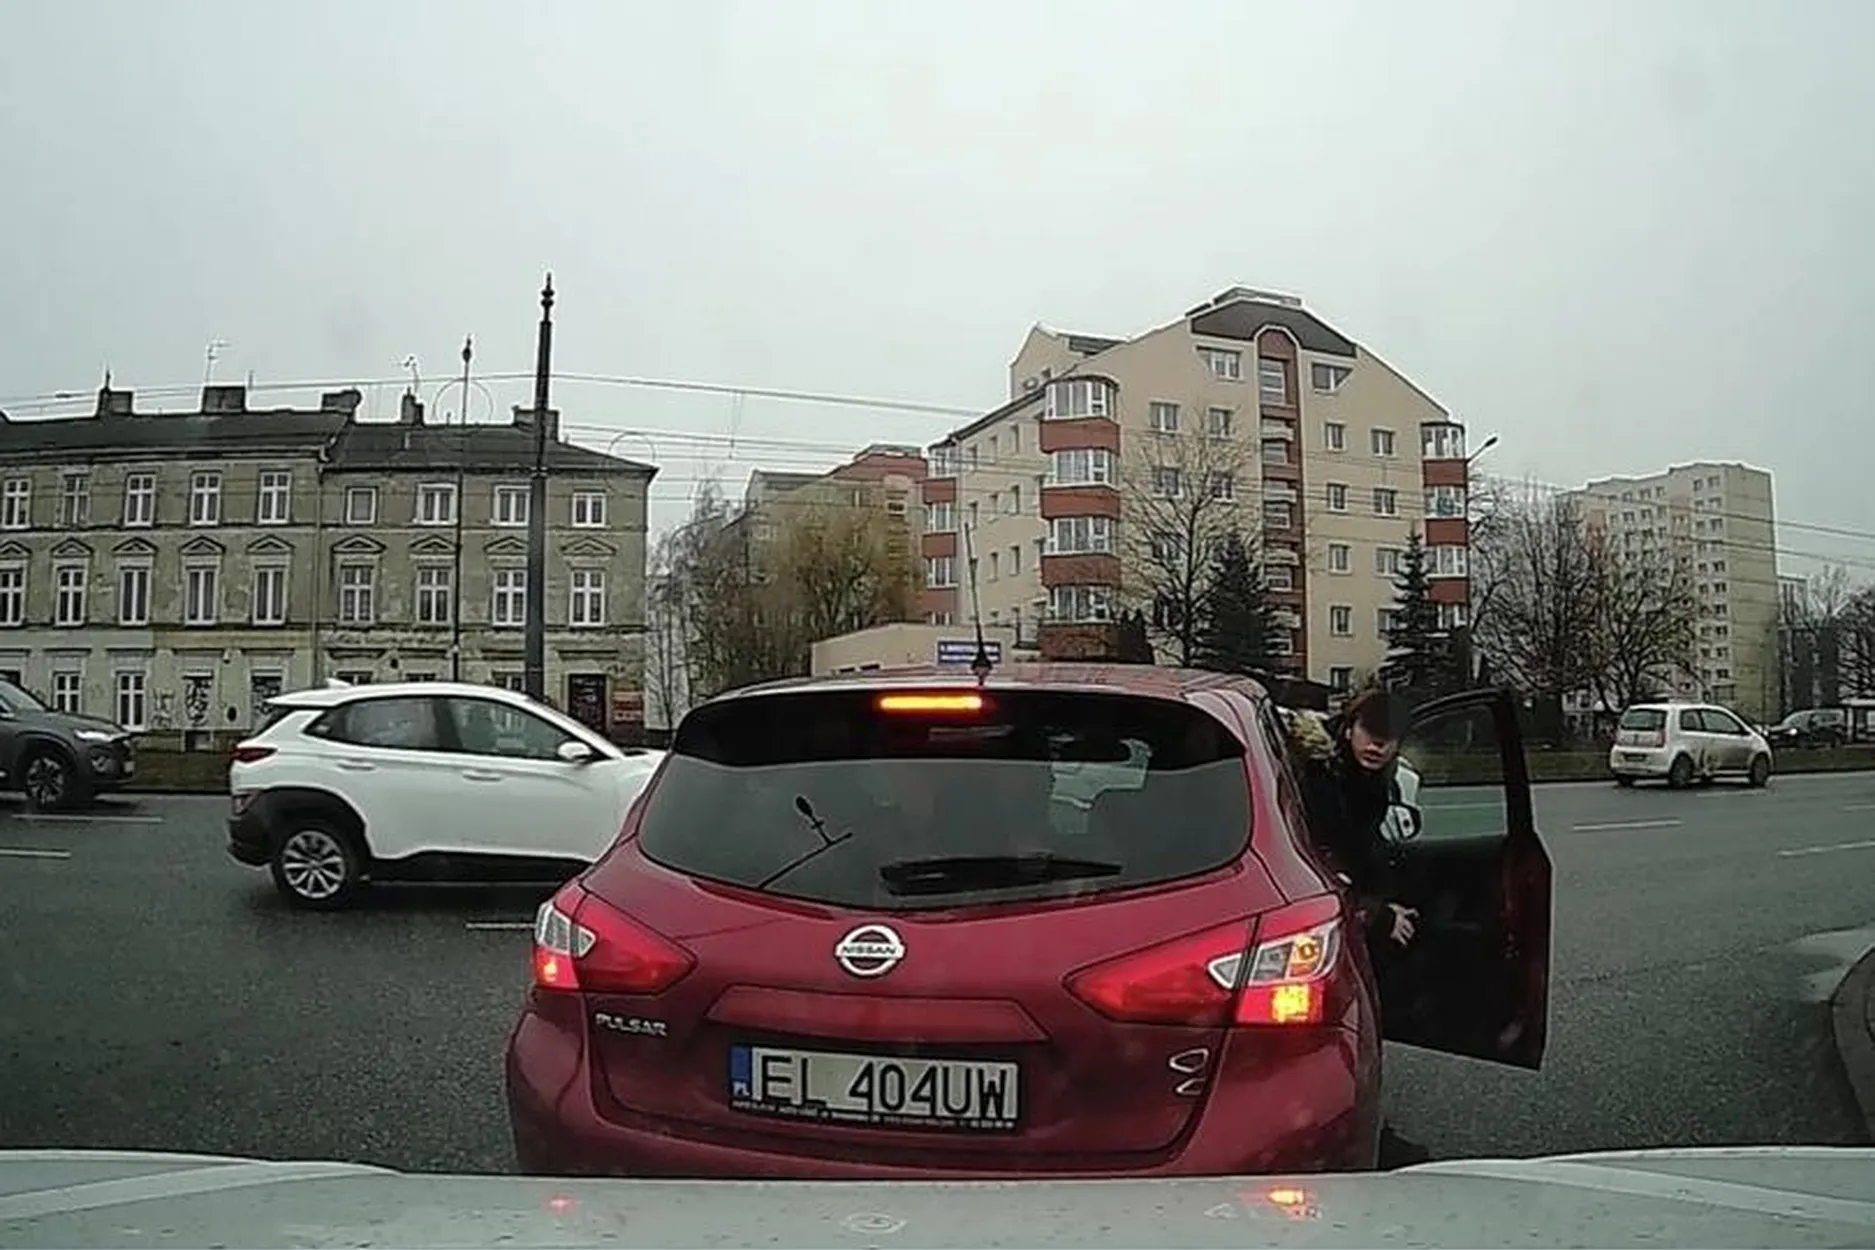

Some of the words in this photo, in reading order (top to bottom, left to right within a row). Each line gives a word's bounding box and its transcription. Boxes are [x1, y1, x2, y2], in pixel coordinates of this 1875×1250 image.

[596, 1013, 667, 1036] PULSAR
[761, 1056, 827, 1107] EL
[848, 1061, 1007, 1118] 404UW
